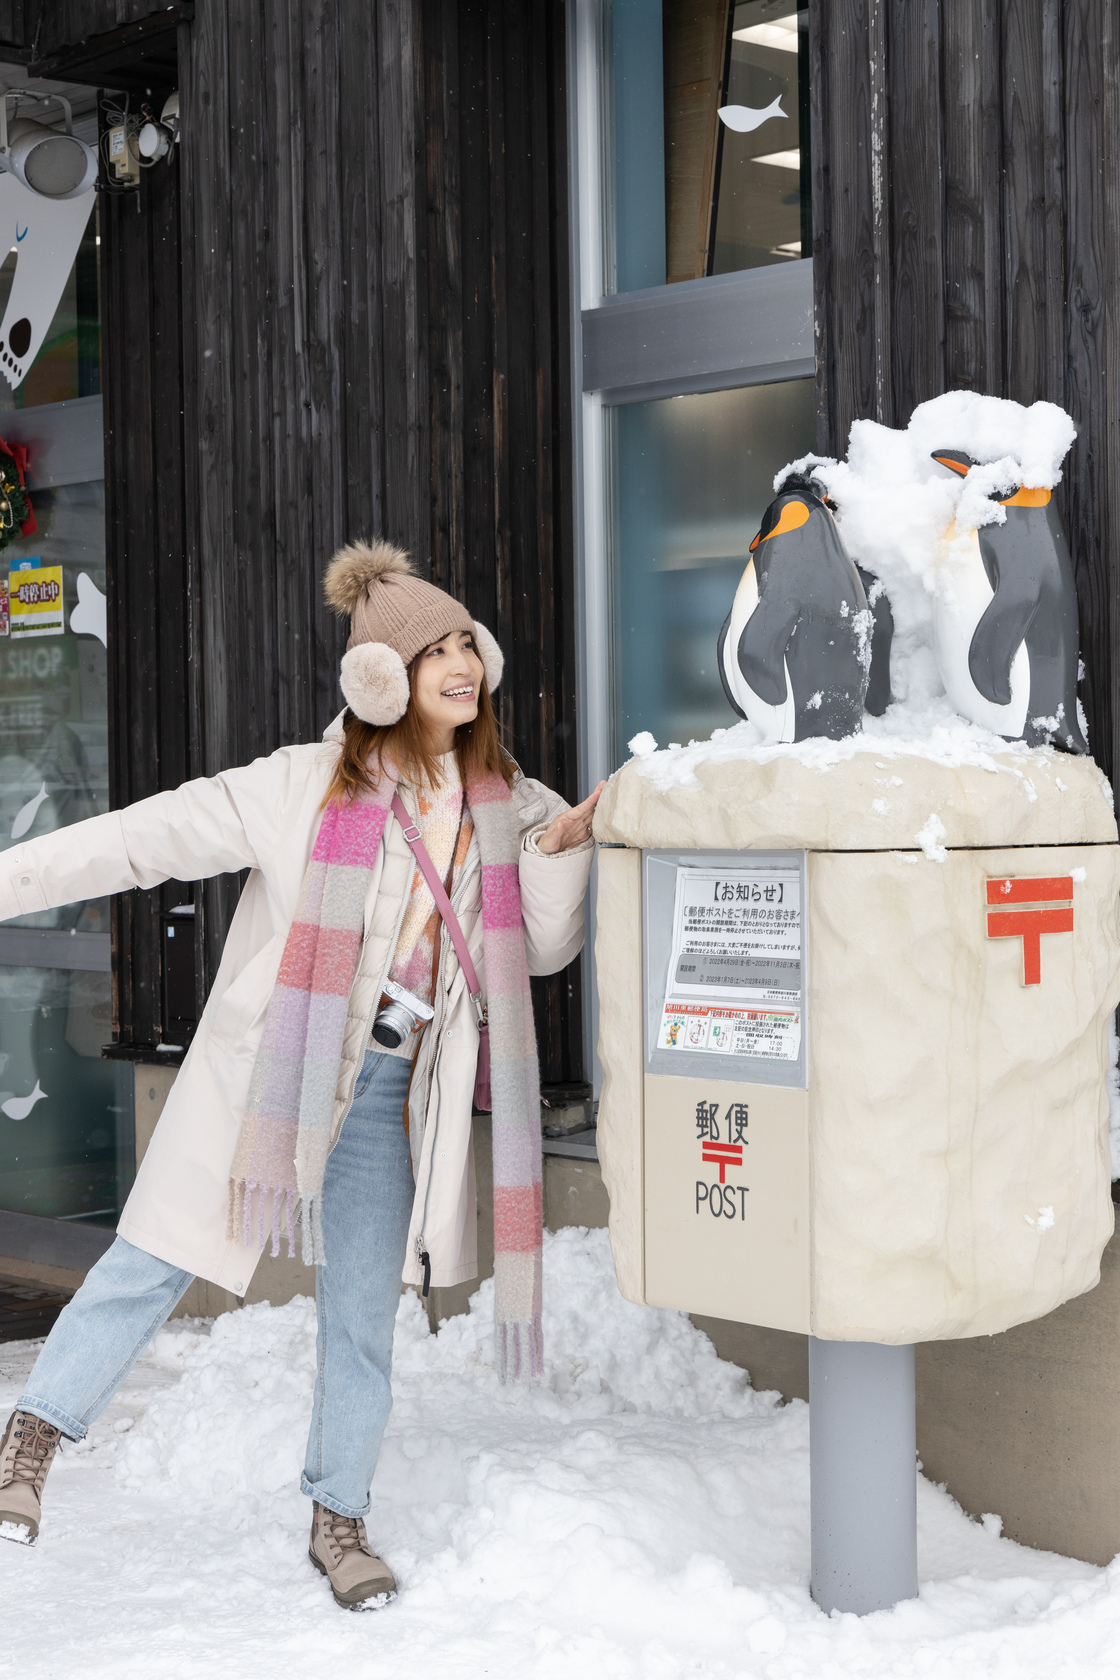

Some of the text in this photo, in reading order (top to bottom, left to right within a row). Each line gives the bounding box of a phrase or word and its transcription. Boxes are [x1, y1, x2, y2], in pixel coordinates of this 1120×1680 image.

[10, 580, 60, 604] 一時停止中
[8, 646, 63, 680] SHOP
[713, 882, 784, 903] 【お知らせ】
[695, 1100, 749, 1145] 郵便
[696, 1181, 749, 1221] POST
